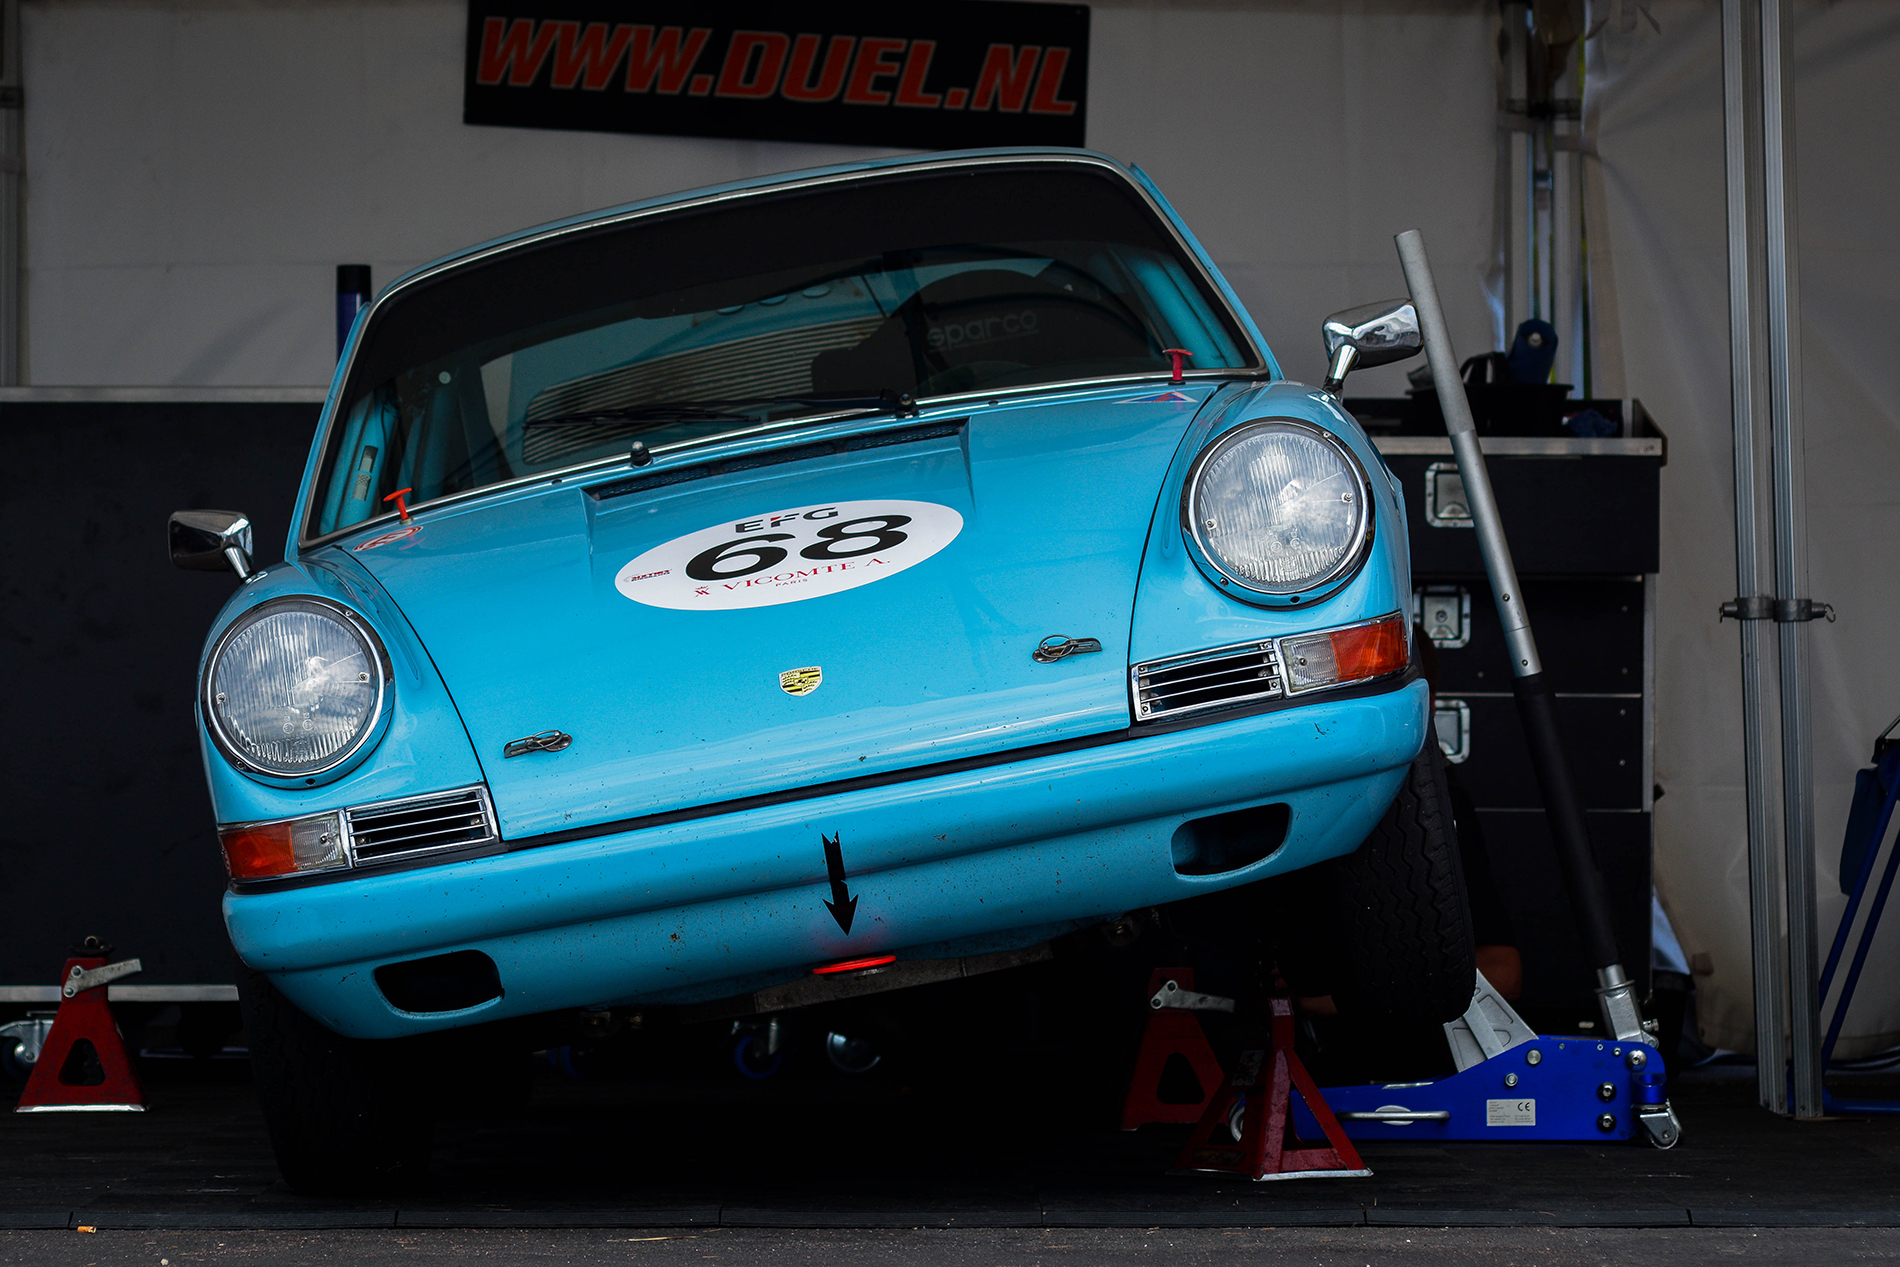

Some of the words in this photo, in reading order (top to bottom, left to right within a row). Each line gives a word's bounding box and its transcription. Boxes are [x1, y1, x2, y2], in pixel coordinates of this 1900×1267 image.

[476, 16, 1077, 115] WWW.DUEL.NL
[927, 310, 1038, 350] sparco
[736, 507, 838, 533] EFG
[686, 515, 912, 581] 68
[723, 561, 856, 590] VICOMTE
[866, 558, 890, 568] A.
[1517, 1102, 1531, 1112] CE
